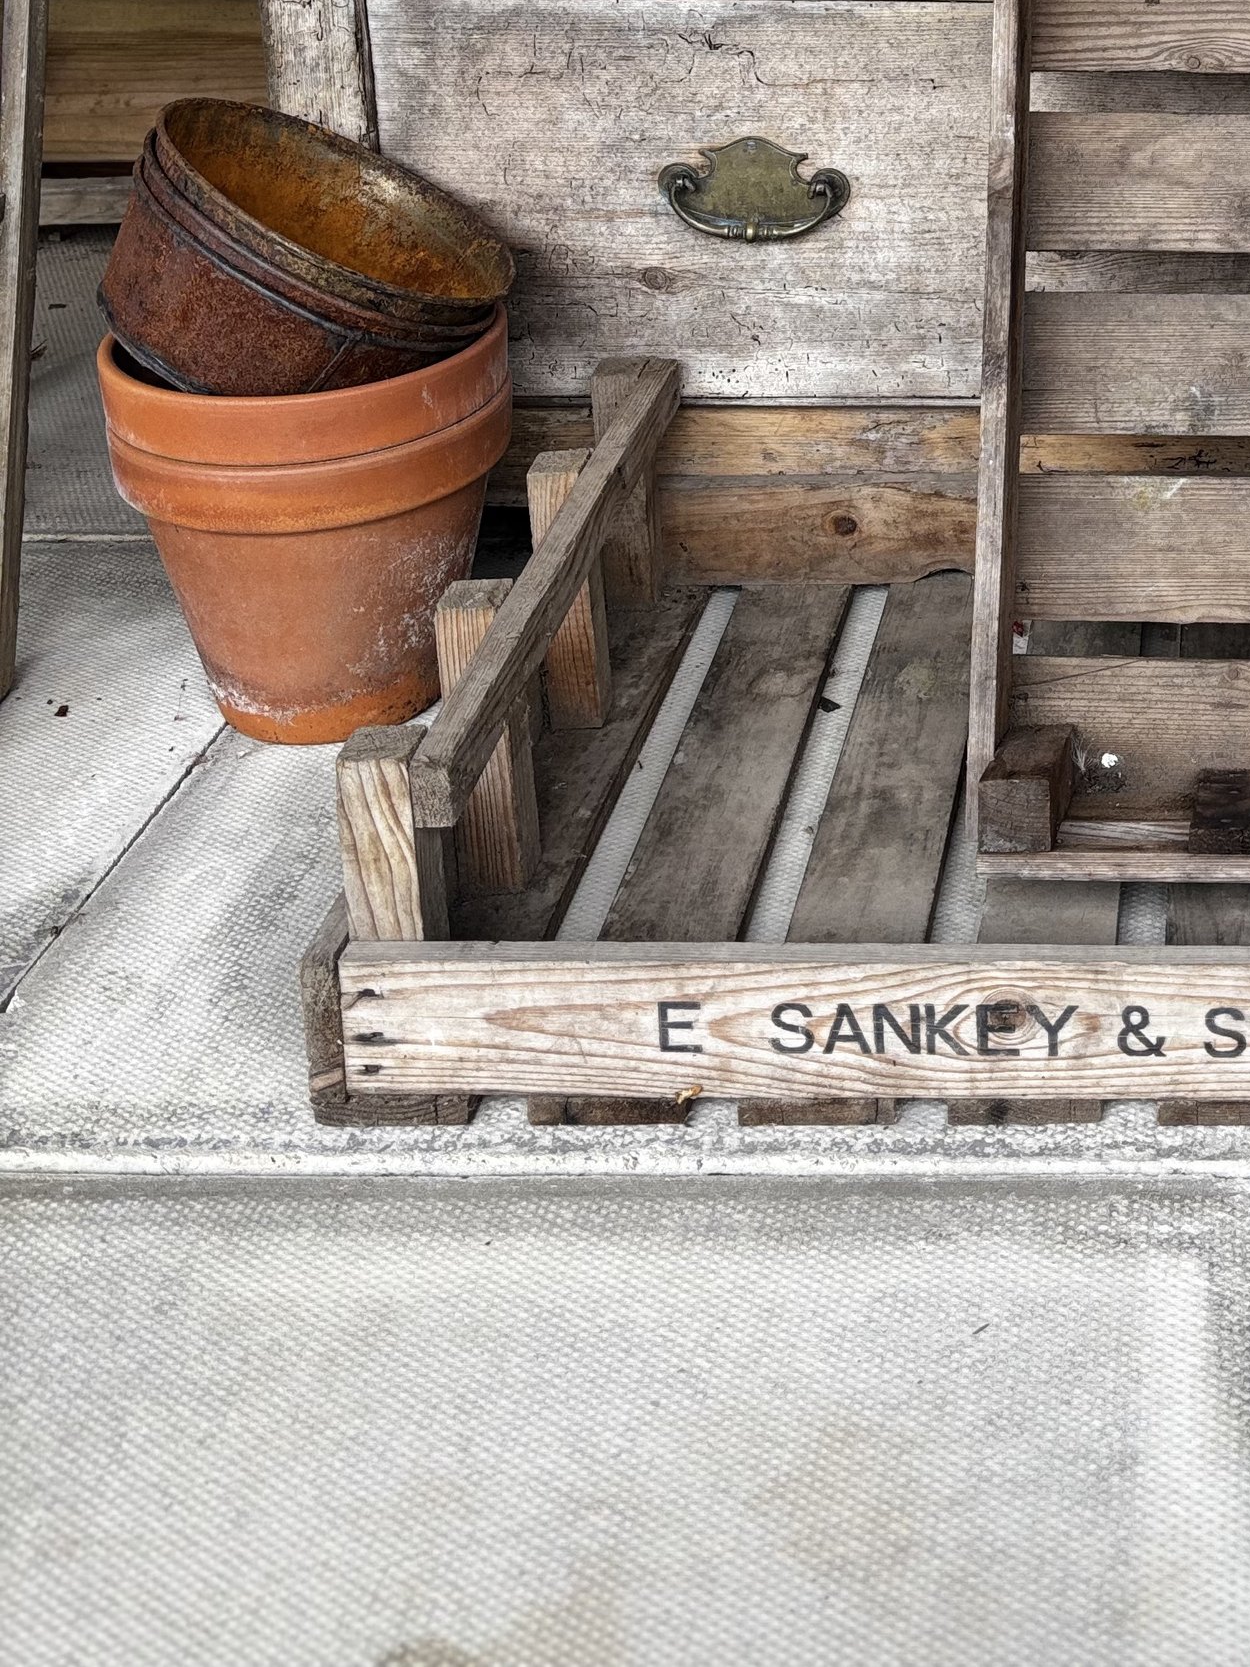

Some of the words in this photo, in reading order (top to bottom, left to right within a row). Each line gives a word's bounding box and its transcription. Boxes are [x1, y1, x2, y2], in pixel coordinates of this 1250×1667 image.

[658, 1001, 702, 1053] E
[770, 1002, 1079, 1056] SANKEY
[1116, 1005, 1166, 1058] &
